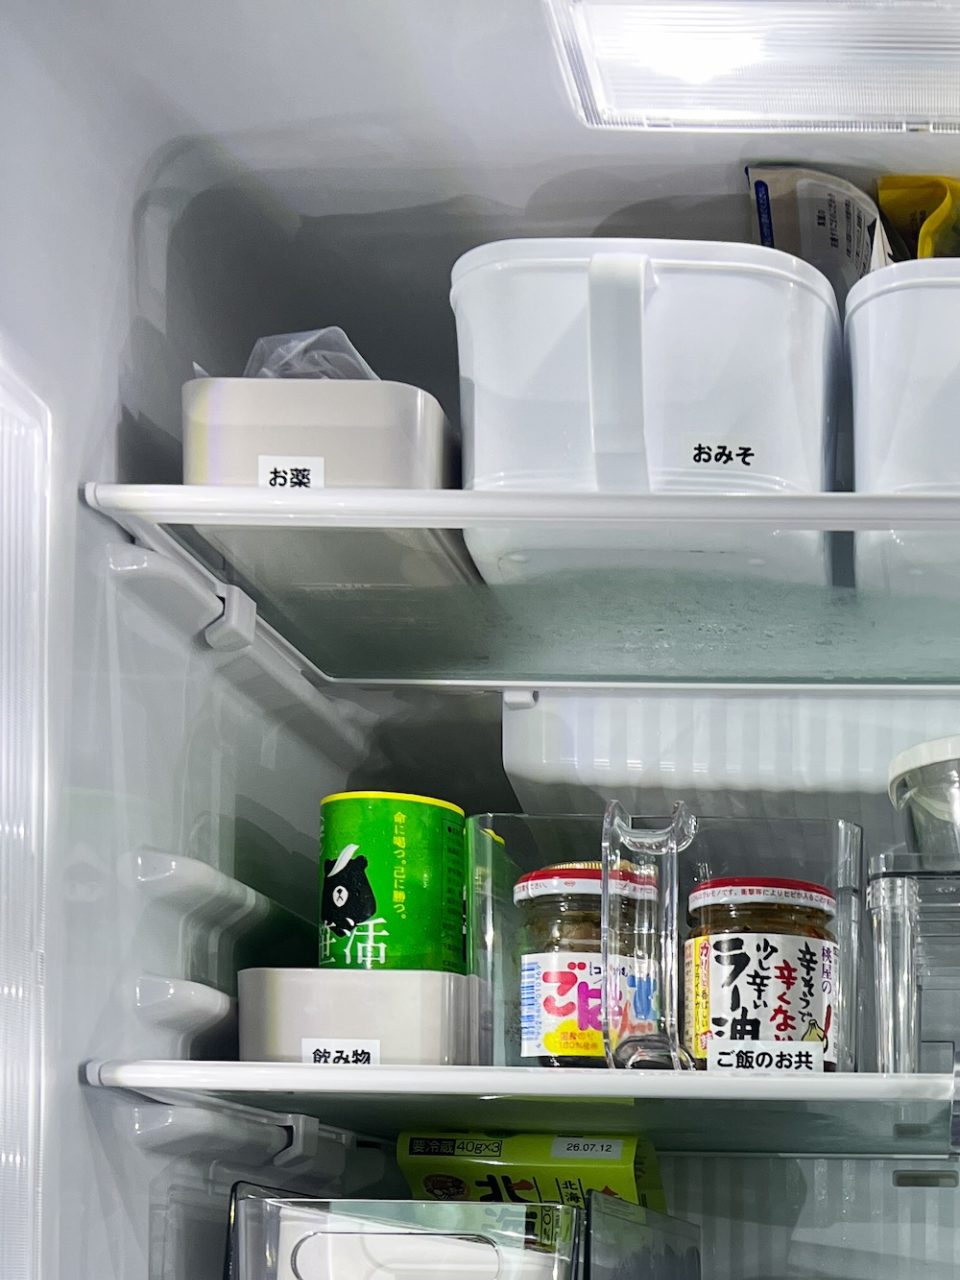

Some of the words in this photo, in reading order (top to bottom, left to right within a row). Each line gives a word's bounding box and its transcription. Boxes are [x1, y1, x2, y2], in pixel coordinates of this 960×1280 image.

[693, 443, 755, 466] おみそ
[269, 467, 311, 488] お薬
[746, 938, 779, 1009] 少し辛い
[821, 946, 832, 994] 桃屋の
[712, 937, 761, 1040] ラー油
[797, 941, 818, 1023] 辛そうで
[312, 1048, 371, 1065] 飲み物
[717, 1051, 813, 1070] ご飯のお共
[566, 1142, 613, 1153] 26.07.12
